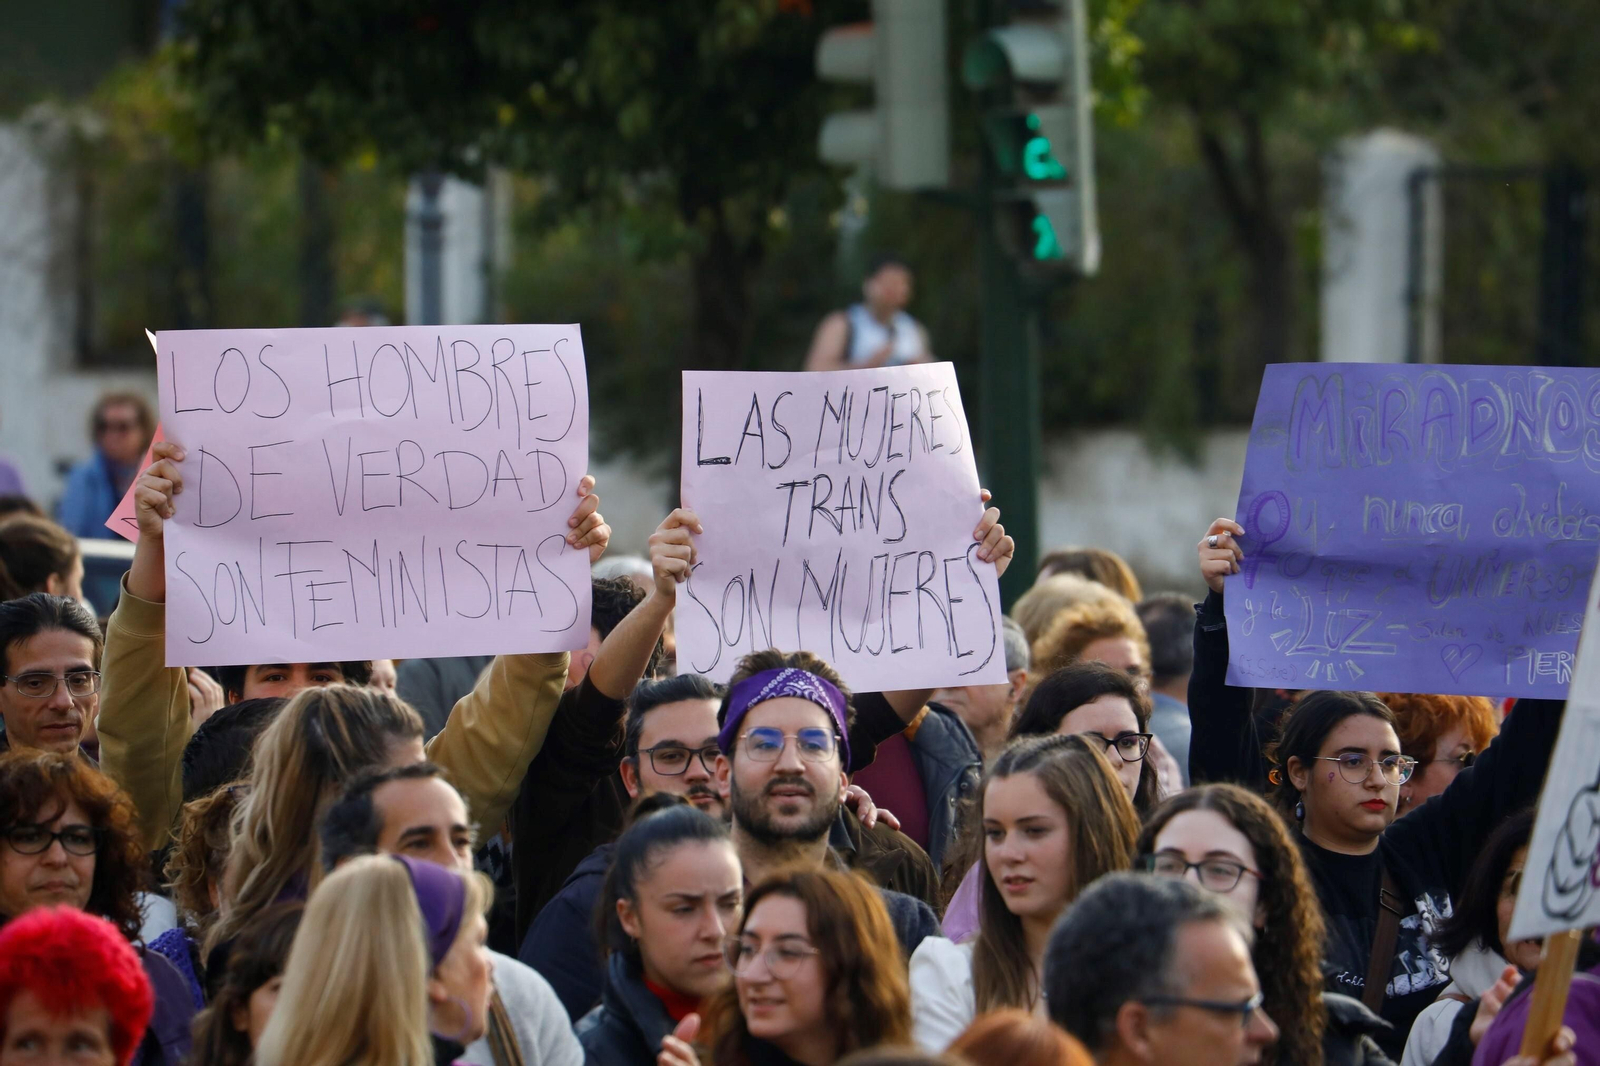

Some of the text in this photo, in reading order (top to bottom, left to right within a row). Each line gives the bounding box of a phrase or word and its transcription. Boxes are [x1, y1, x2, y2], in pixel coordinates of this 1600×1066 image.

[171, 335, 577, 450] LOS HOMBRES
[696, 385, 964, 470] LAS MUJERES
[193, 436, 568, 528] DE VERDAD
[775, 468, 906, 547] TRANS
[1363, 494, 1470, 541] nunca
[175, 533, 579, 644] SON FEMINISTAS
[686, 541, 997, 677] SON MUJERES
[1285, 595, 1397, 657] LUZ
[1522, 606, 1584, 639] NUES
[1504, 645, 1577, 685] PIER
